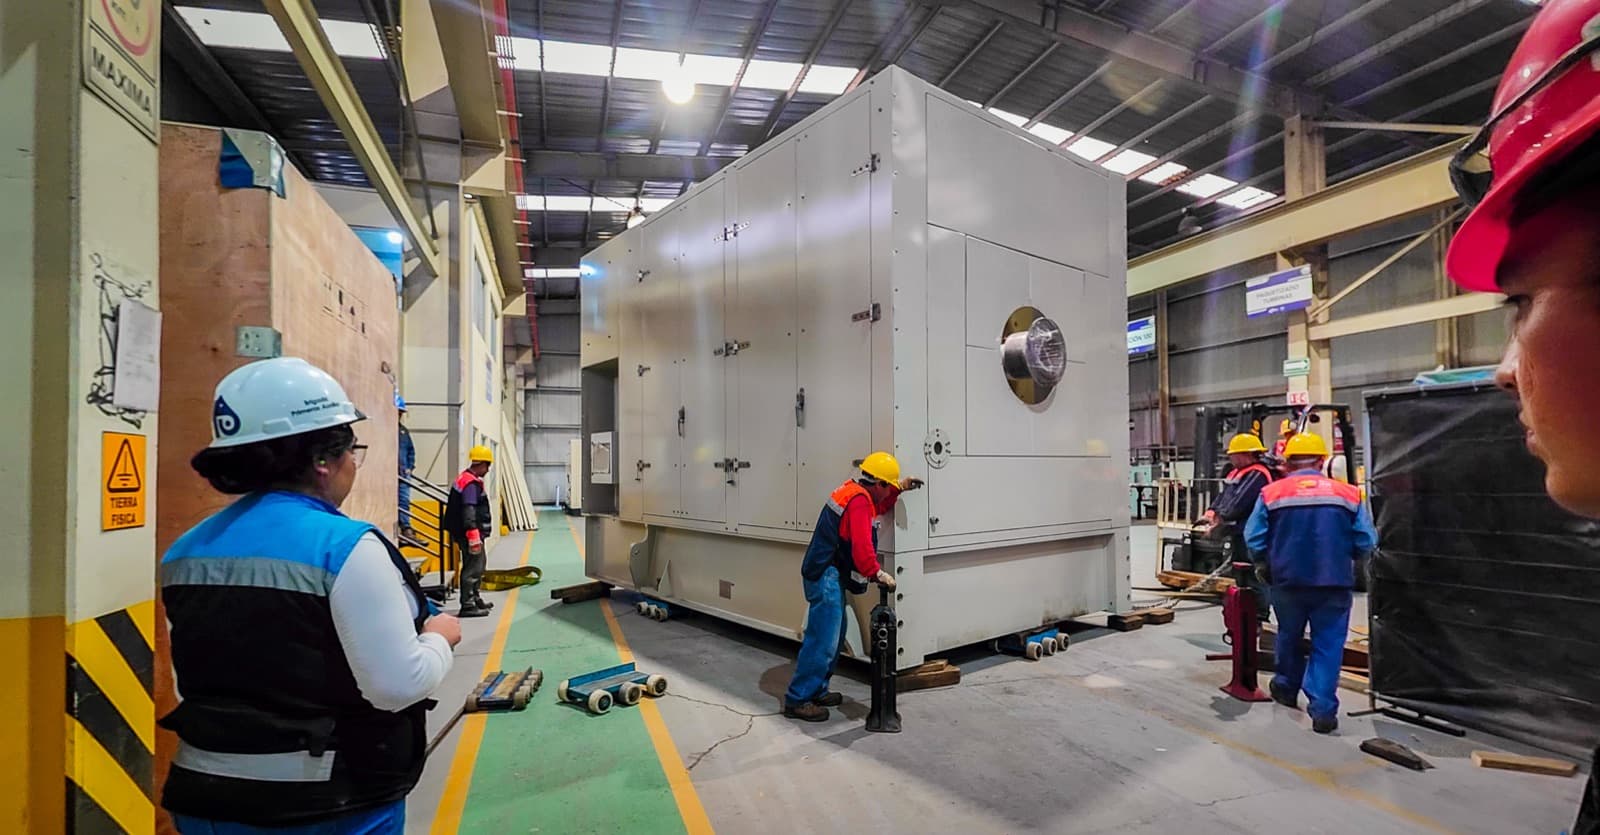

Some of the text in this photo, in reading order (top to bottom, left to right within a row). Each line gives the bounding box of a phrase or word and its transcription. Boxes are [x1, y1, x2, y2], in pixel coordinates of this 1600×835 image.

[91, 46, 153, 117] MAXIMA
[291, 406, 321, 417] Primeros
[110, 496, 138, 508] TIERRA
[111, 512, 137, 526] FISICA
